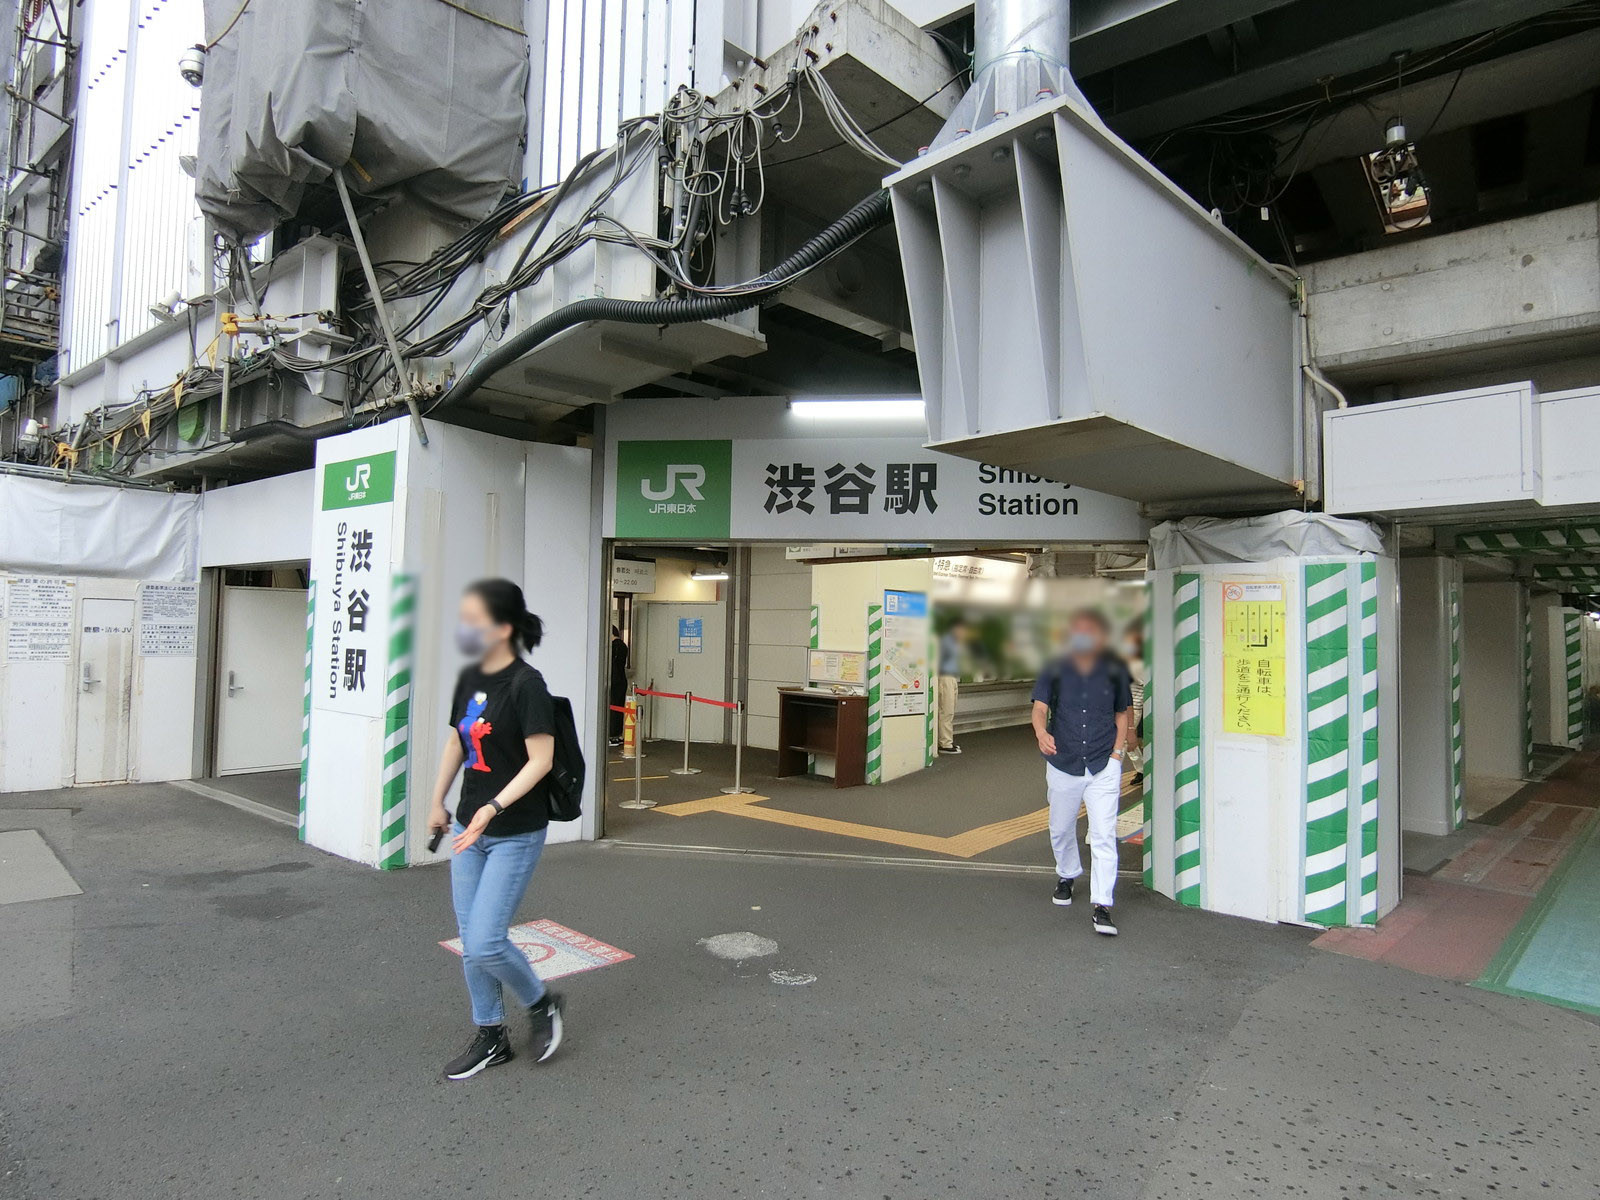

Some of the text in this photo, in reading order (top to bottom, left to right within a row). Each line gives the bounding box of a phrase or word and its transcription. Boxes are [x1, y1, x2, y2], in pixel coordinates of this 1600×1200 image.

[346, 463, 371, 492] JR
[641, 464, 706, 500] JR
[763, 462, 938, 515] 渋谷駅
[649, 503, 697, 514] JR東日本
[978, 493, 1079, 515] Station
[329, 522, 348, 699] Shibuya Station
[343, 529, 373, 692] 渋谷駅
[1236, 658, 1252, 731] 歩道をご通行ください。
[1257, 659, 1272, 697] 自転車は、
